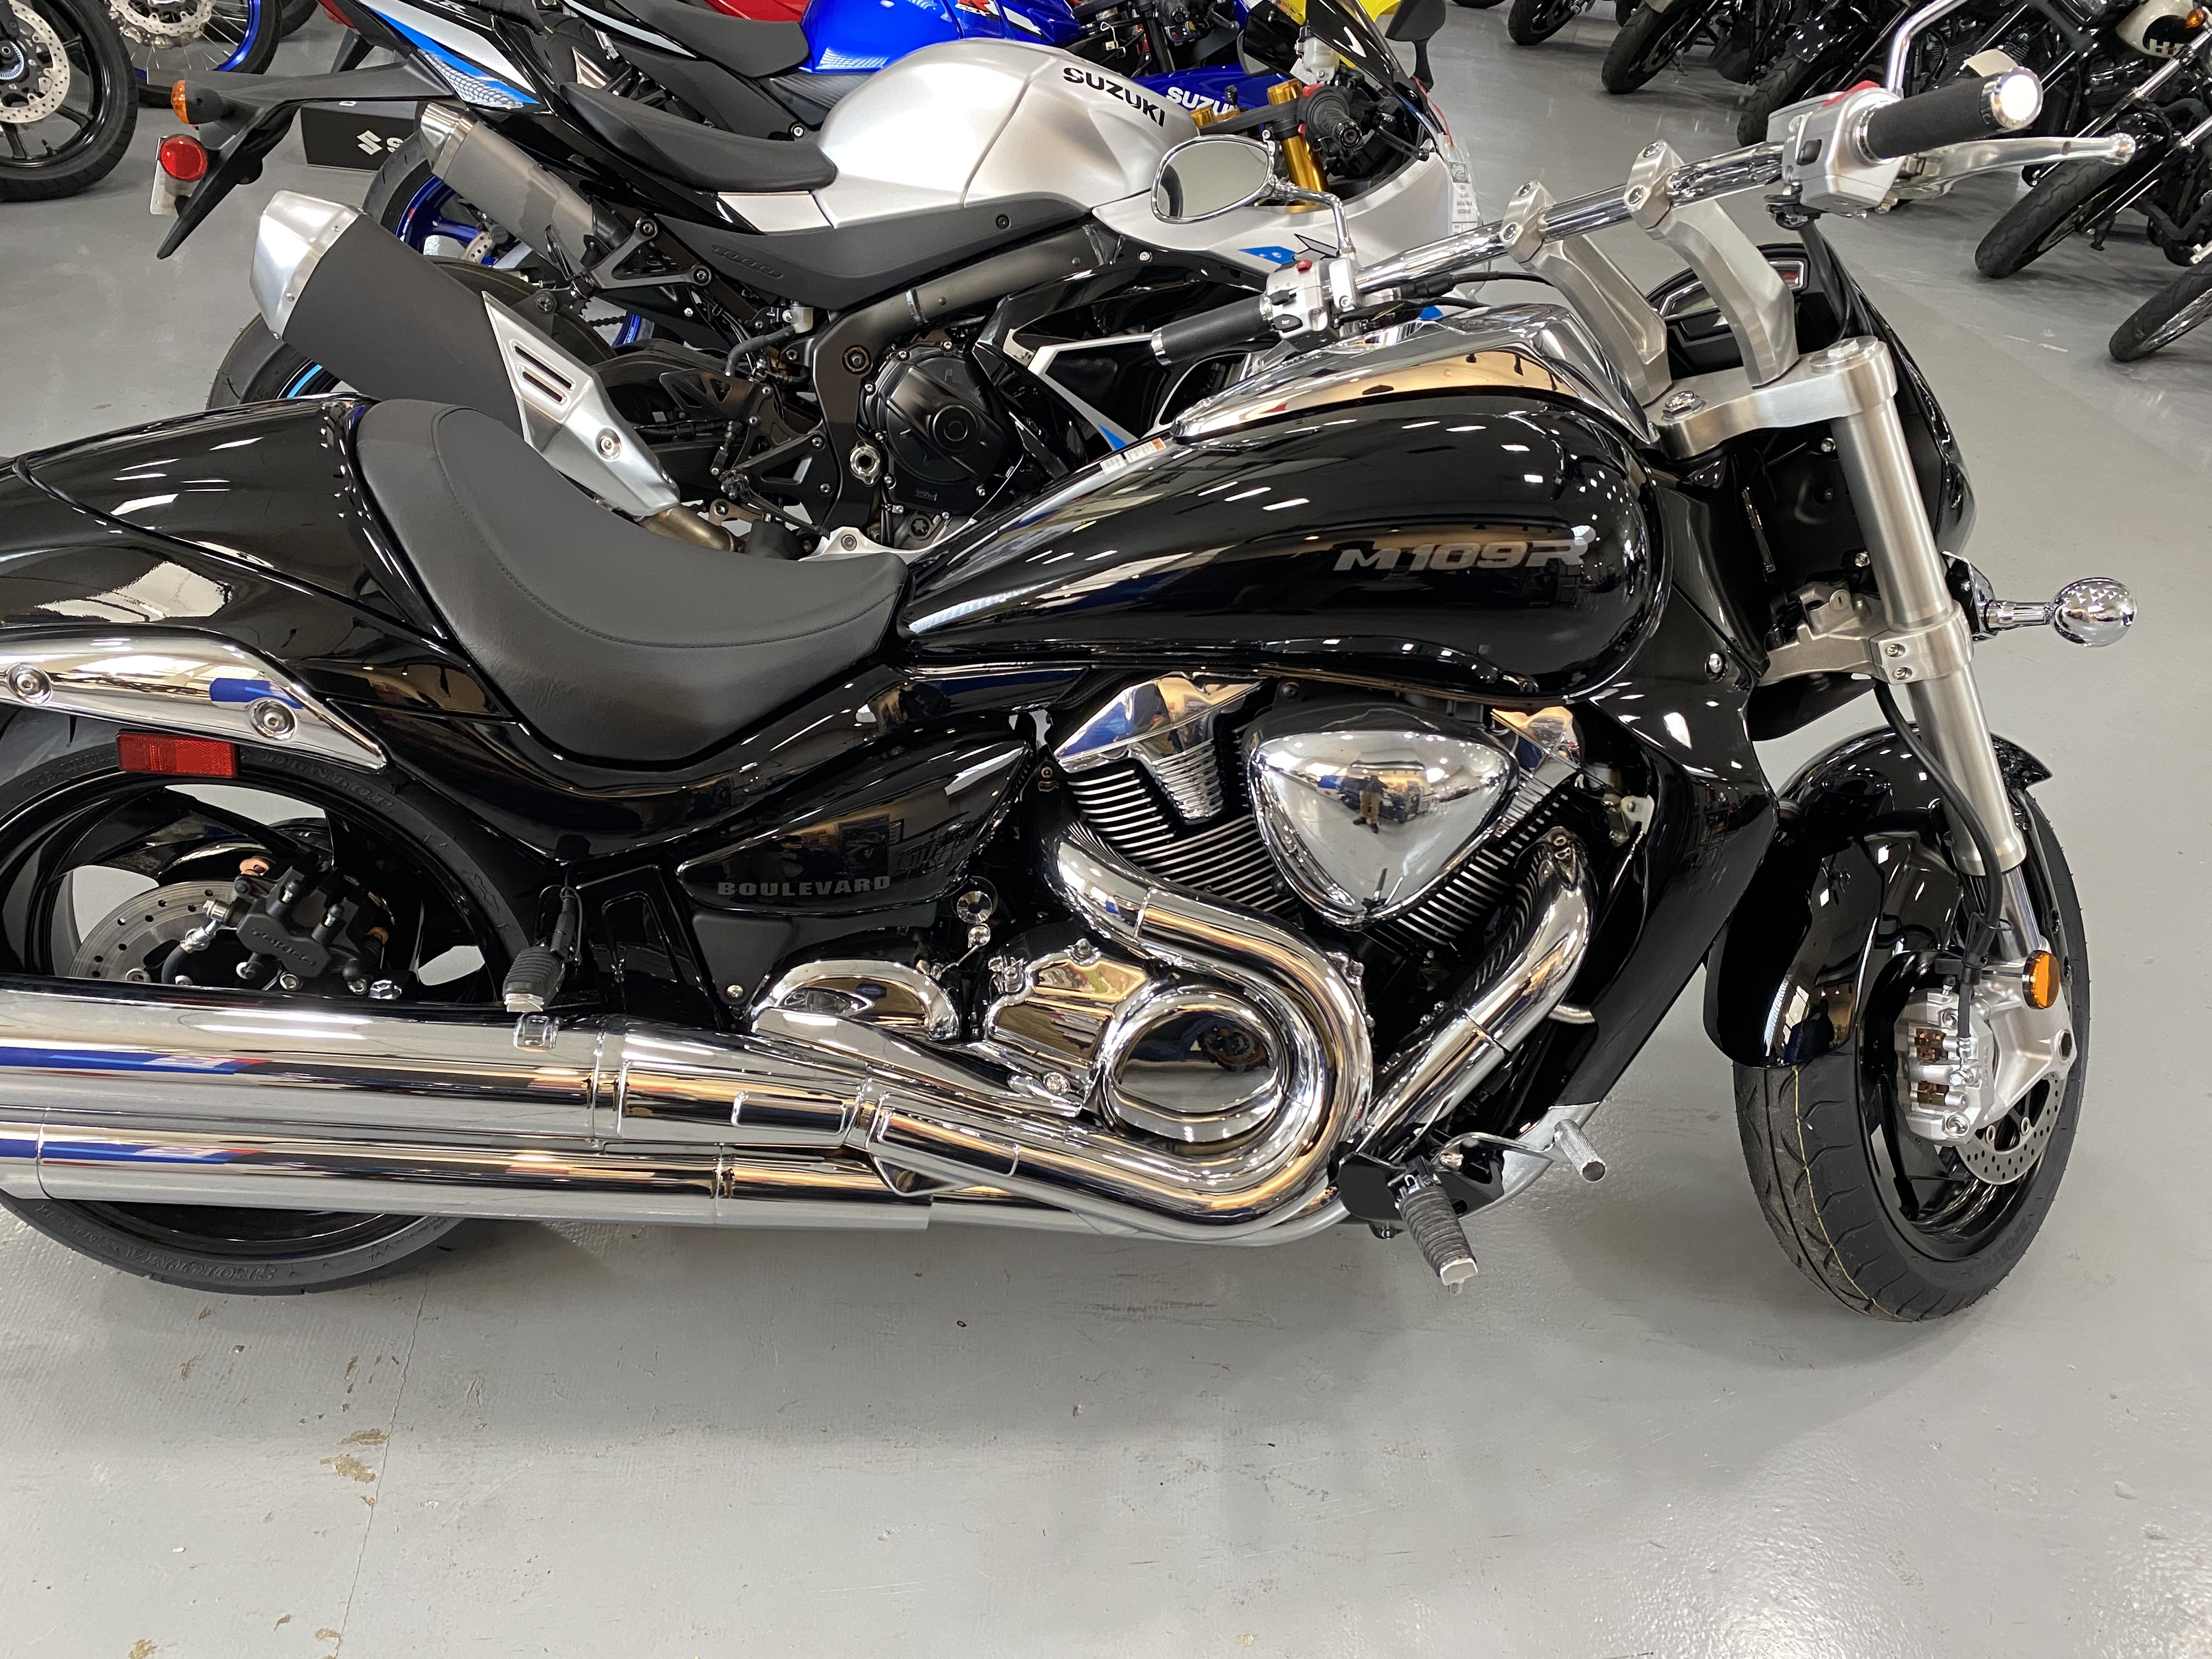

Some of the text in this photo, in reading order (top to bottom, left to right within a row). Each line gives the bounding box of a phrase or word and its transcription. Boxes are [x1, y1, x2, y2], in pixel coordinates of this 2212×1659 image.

[1063, 67, 1165, 127] SUZUKI
[1166, 86, 1234, 116] SUZU
[1333, 539, 1589, 571] M109R
[260, 753, 395, 808] DUNLOP
[717, 876, 891, 896] BOULEVARD
